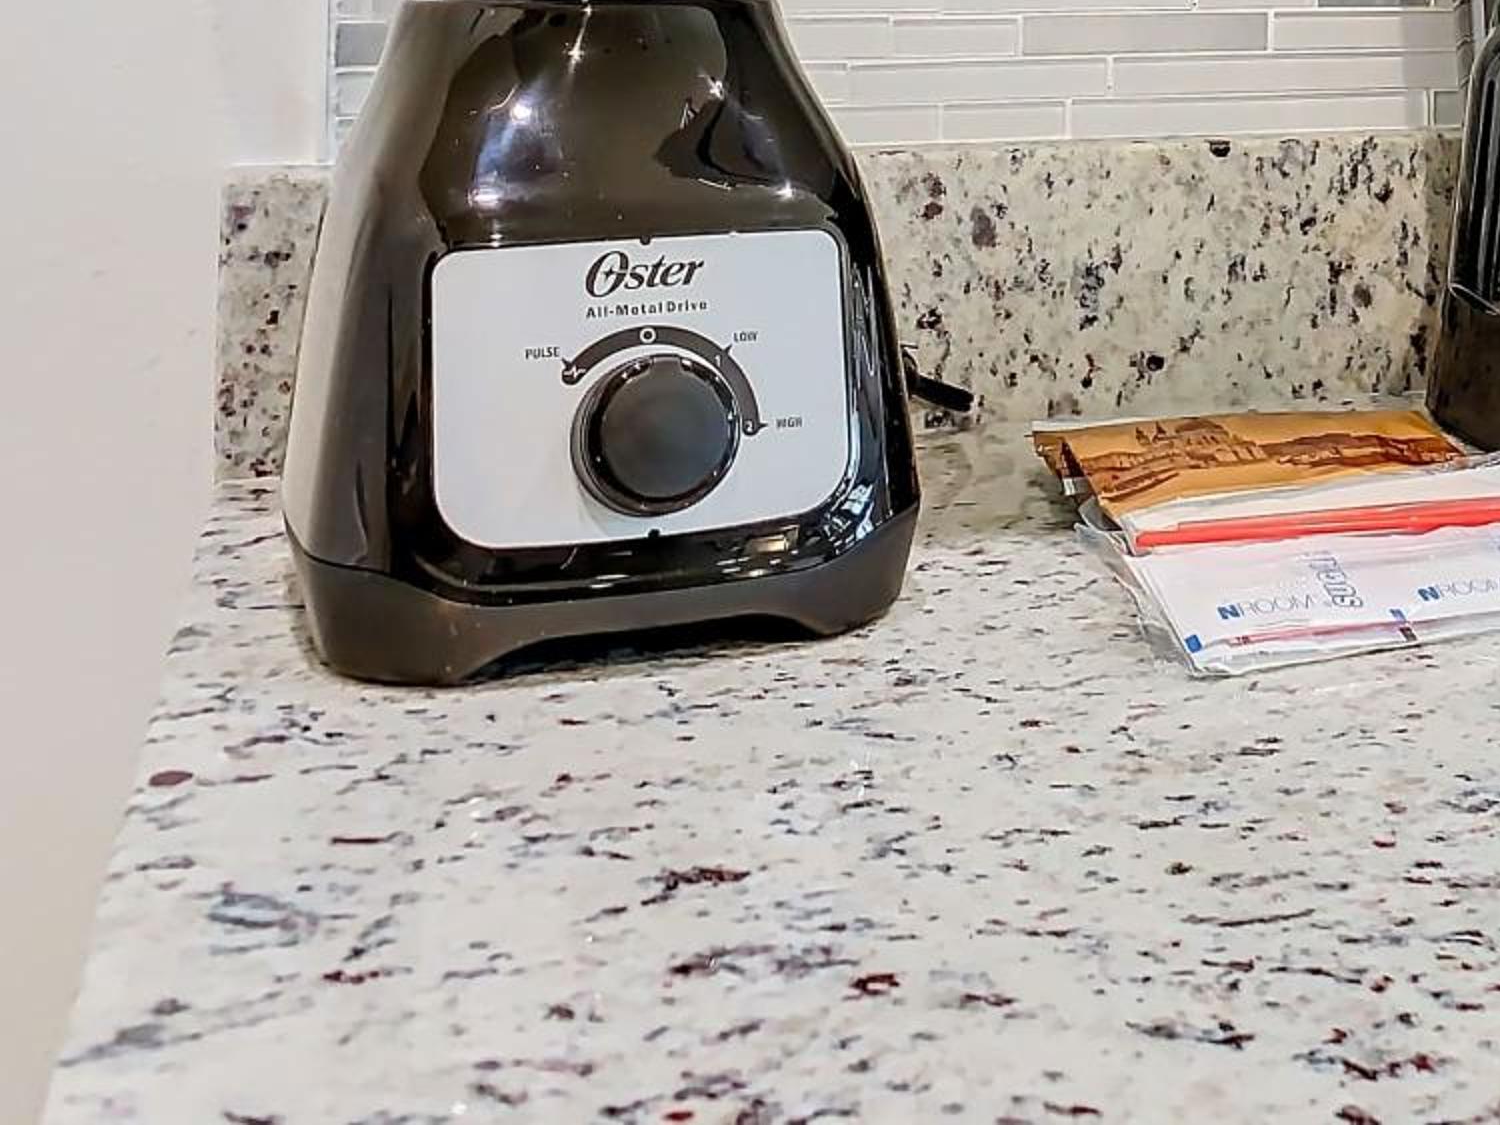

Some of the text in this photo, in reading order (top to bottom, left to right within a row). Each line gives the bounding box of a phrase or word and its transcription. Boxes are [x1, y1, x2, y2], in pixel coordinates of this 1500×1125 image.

[585, 250, 705, 298] Oster
[585, 298, 708, 318] All-Metal Drive
[733, 330, 758, 344] LOW
[525, 346, 560, 360] PULSE
[775, 416, 803, 429] HIGH
